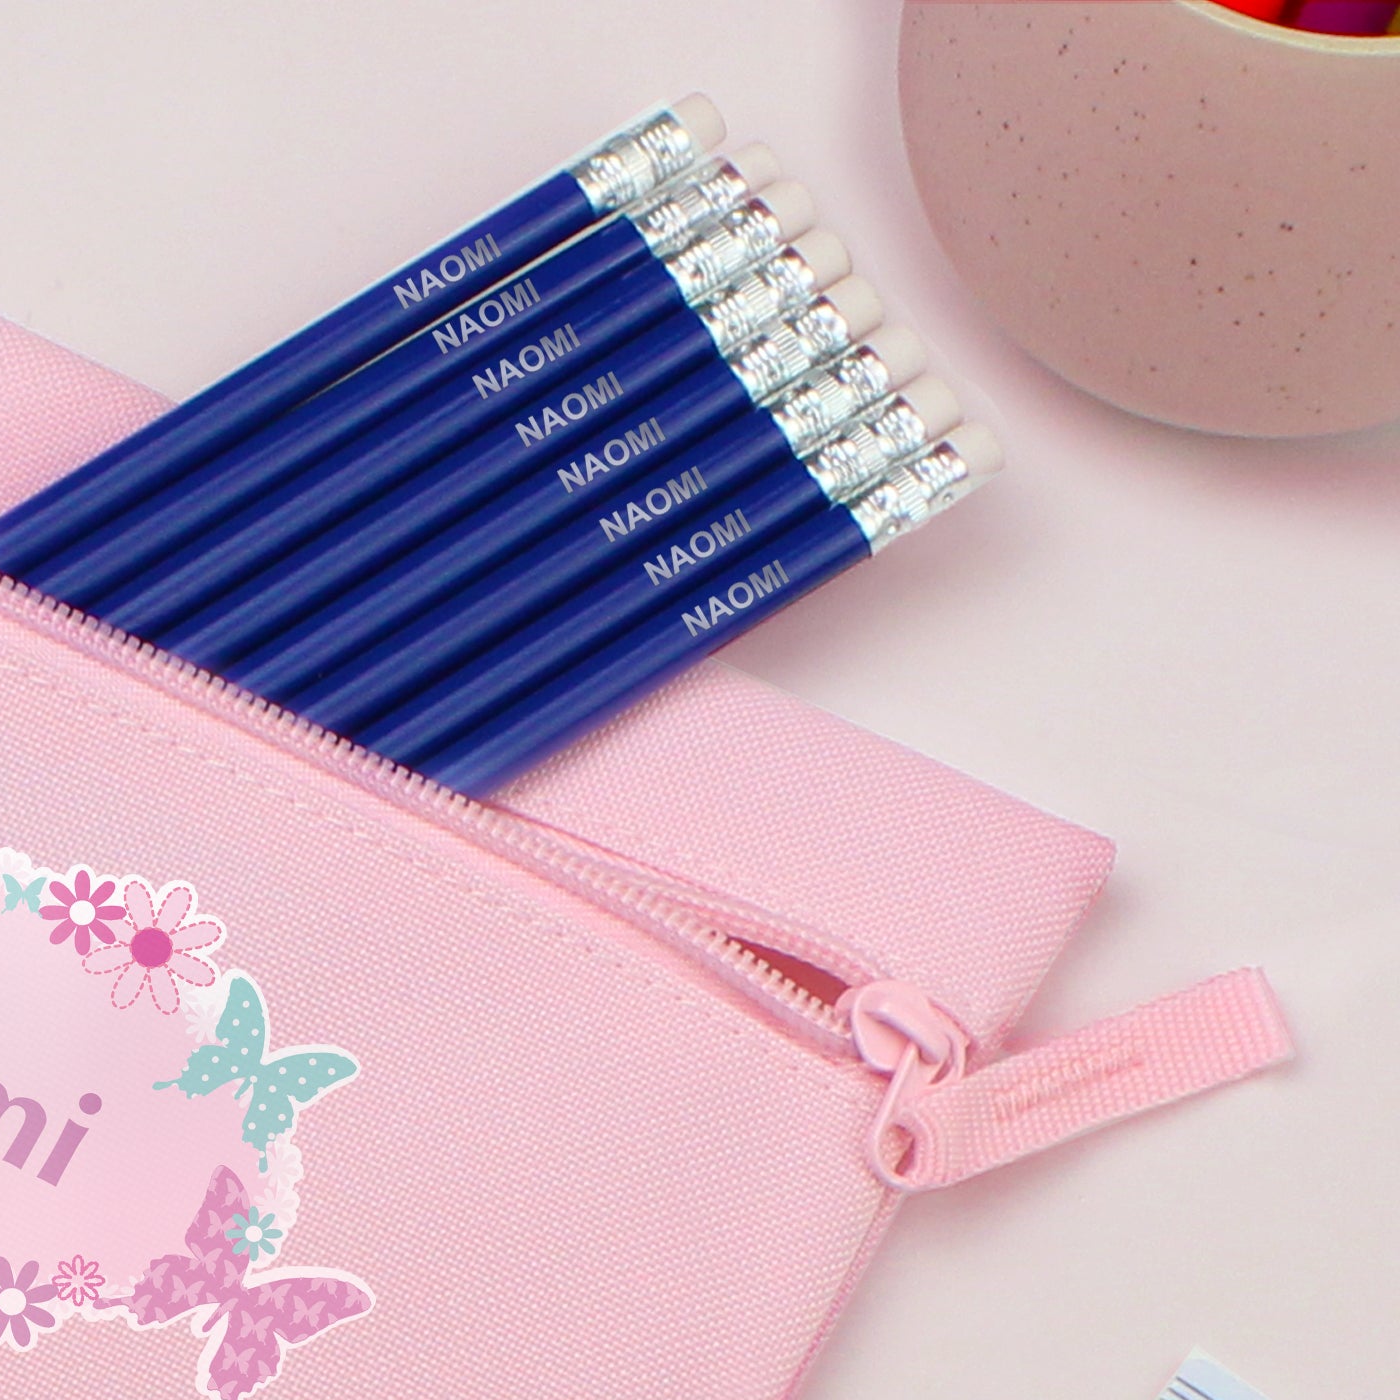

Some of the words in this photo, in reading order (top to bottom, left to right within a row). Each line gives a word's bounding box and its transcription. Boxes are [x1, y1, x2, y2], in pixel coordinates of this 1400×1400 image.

[393, 233, 502, 309] NAOMI
[431, 278, 541, 354] NAOMI
[471, 323, 581, 400] NAOMI
[514, 371, 625, 447] NAOMI
[556, 417, 667, 493] NAOMI
[599, 466, 709, 543] NAOMI
[643, 509, 753, 586] NAOMI
[681, 560, 790, 637] NAOMI
